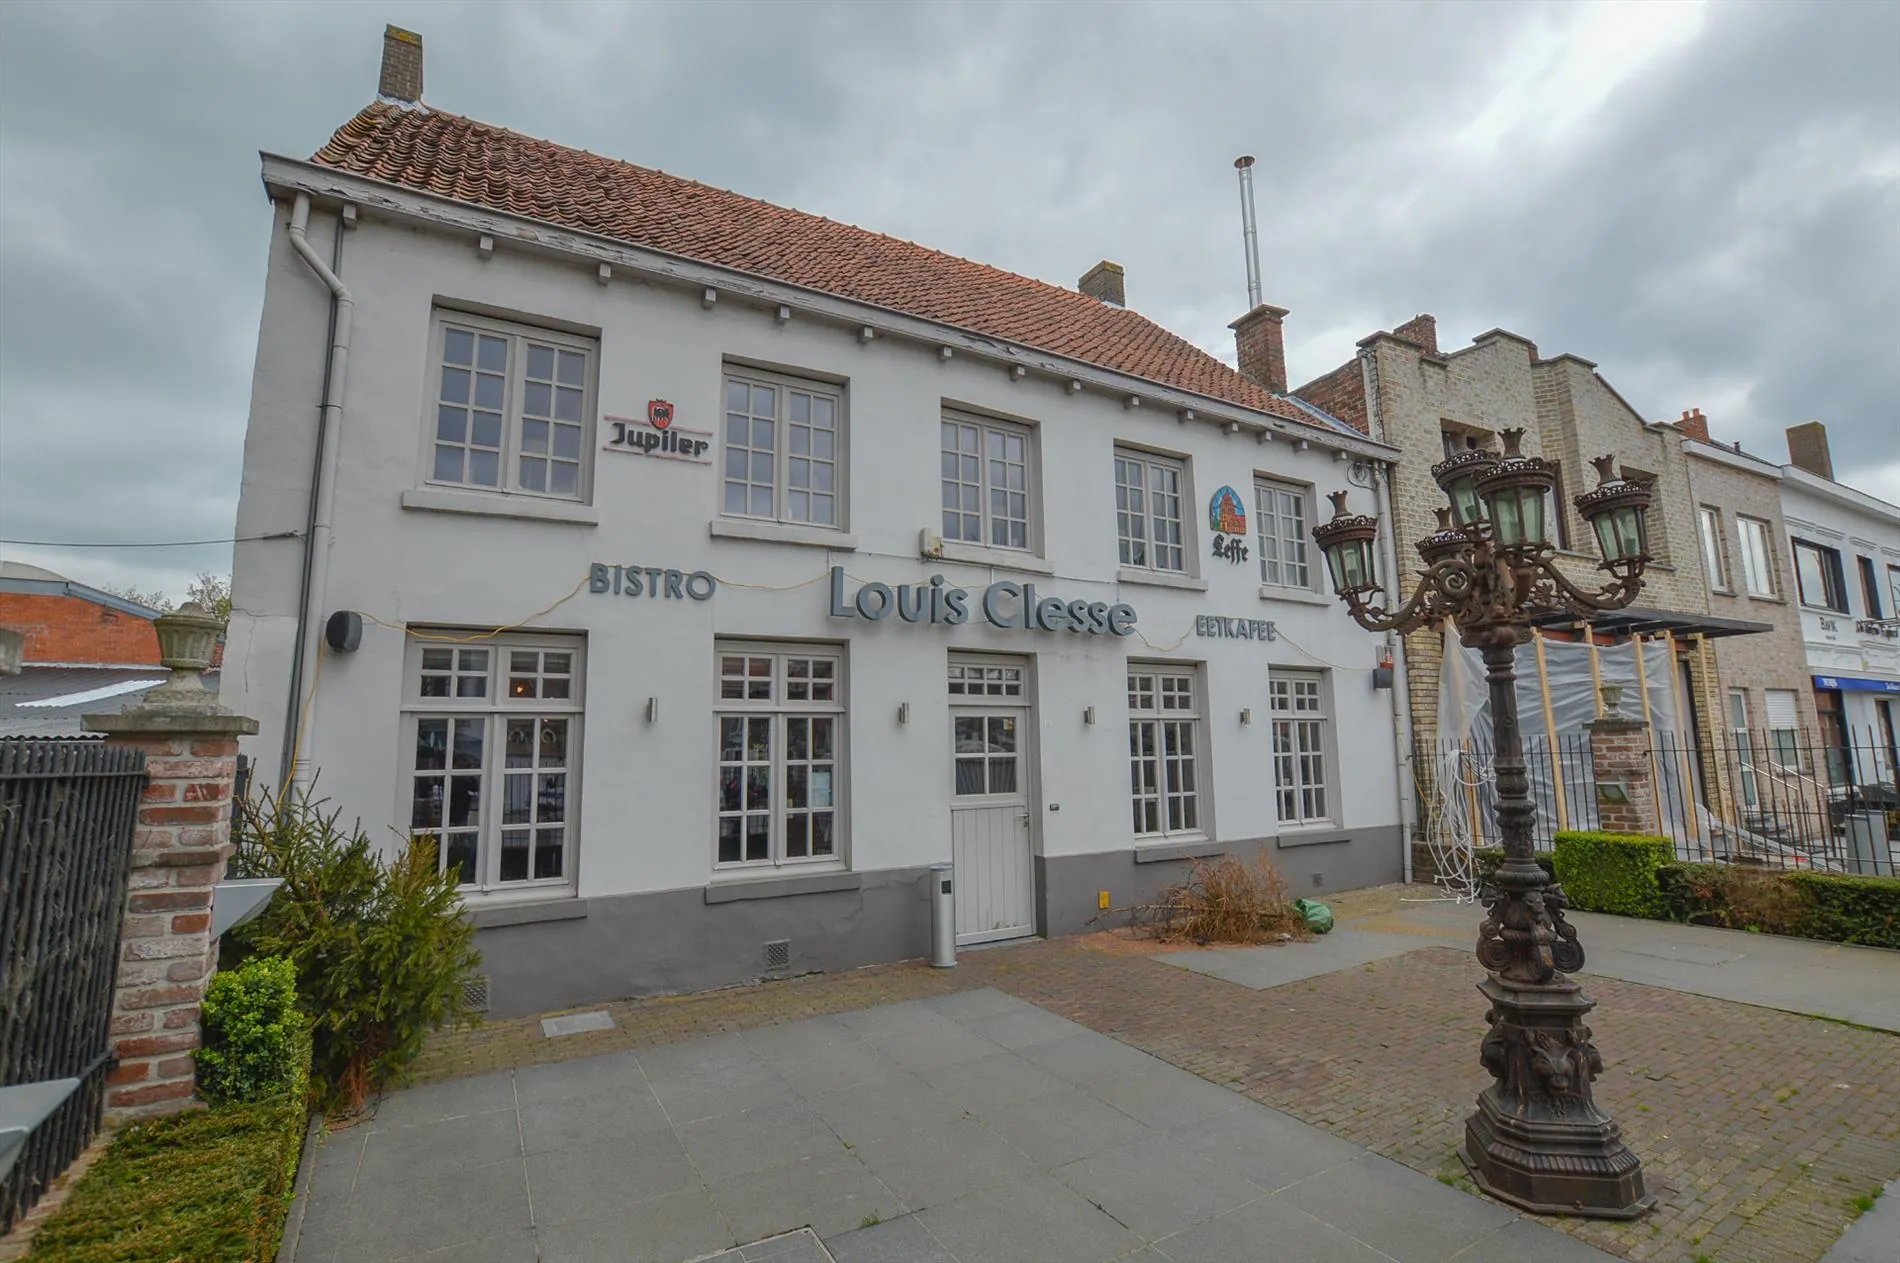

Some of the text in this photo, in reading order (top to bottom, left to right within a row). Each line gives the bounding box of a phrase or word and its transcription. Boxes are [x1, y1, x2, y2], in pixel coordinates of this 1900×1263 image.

[610, 421, 709, 457] Jupiler
[1212, 533, 1249, 565] Leffe
[590, 562, 716, 600] BISTRO
[830, 566, 1138, 636] Louis Clesse
[1196, 614, 1276, 641] EETKAFEE
